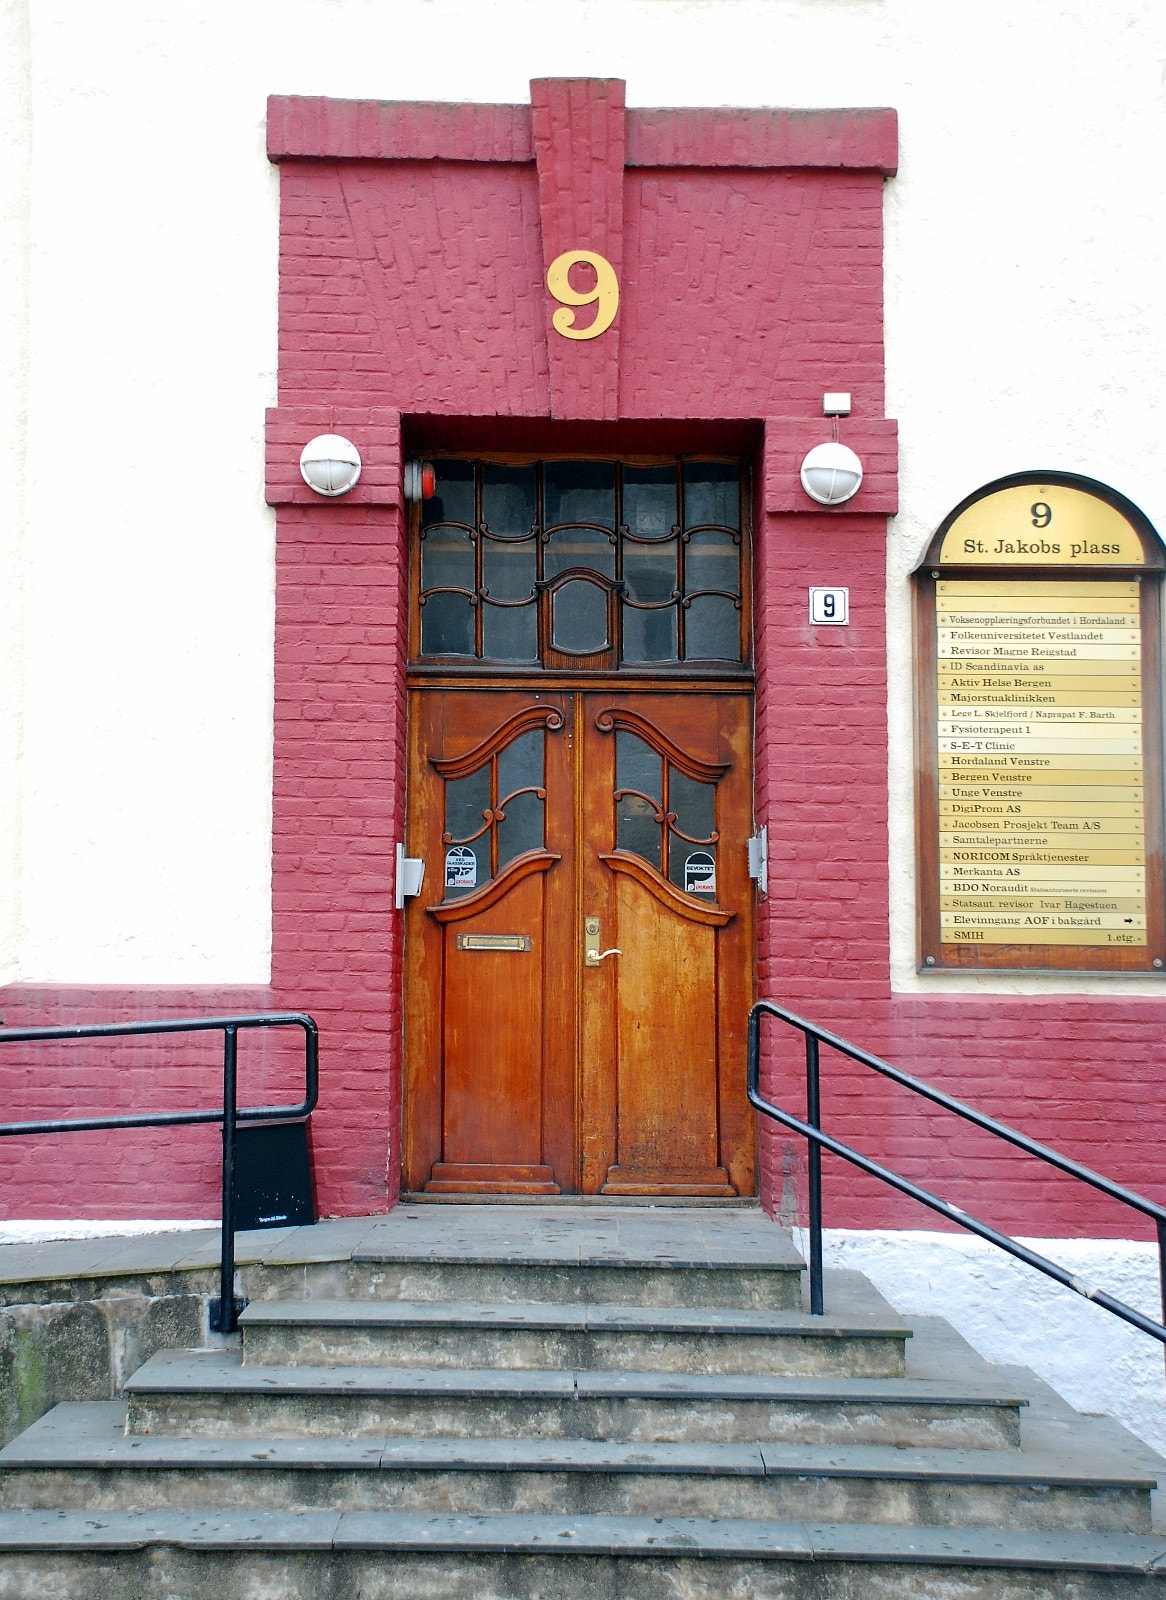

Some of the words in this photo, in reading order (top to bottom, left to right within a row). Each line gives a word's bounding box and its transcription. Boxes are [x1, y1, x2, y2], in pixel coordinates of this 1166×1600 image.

[547, 250, 619, 340] 9
[1030, 502, 1051, 528] 9
[964, 539, 988, 554] St.
[994, 539, 1060, 554] Jakobs
[1070, 540, 1120, 558] plass
[824, 594, 835, 617] 9
[950, 616, 1071, 625] Voksenopplæringsforbundet
[1073, 616, 1077, 624] i
[1079, 617, 1125, 625] Hordaland
[950, 632, 1046, 640] Folkeuniversitetet
[1048, 632, 1103, 640] Vestlandet
[951, 647, 990, 655] Revisor
[993, 647, 1028, 657] Magne
[1031, 648, 1077, 657] Reigstad
[950, 662, 962, 670] ID
[966, 663, 1029, 671] Scandinavia
[1014, 679, 1052, 689] Bergen
[950, 694, 1055, 704] Majorstuaklinikken
[952, 710, 972, 718] Lege
[985, 710, 1027, 719] Skjelfjord
[1035, 711, 1076, 720] Naprapat
[951, 726, 1023, 735] Fysioterapeut
[1026, 726, 1031, 734] 1
[985, 742, 1015, 750] Clinic
[951, 757, 1007, 765] Hordaland
[1010, 758, 1050, 766] Venstre
[951, 773, 989, 782] Bergen
[952, 789, 979, 798] Unge
[982, 789, 1022, 797] Venstre
[952, 805, 1003, 814] DigiProm
[1006, 805, 1021, 813] AS
[952, 821, 999, 829] Jacobsen
[1003, 821, 1047, 831] Prosjekt
[1083, 822, 1100, 830] A/S
[952, 836, 1048, 847] Samtalepartnerne
[1012, 853, 1089, 863] Språktjenester
[981, 884, 1028, 892] Noraudit
[952, 900, 996, 908] Statsaut.
[1040, 901, 1061, 909] Ivar
[1065, 901, 1117, 911] Hagestuen
[953, 916, 1020, 926] Elevinngang
[1024, 917, 1049, 925] AOF
[1058, 917, 1101, 926] bakgård
[1107, 934, 1135, 943] 1.etg.
